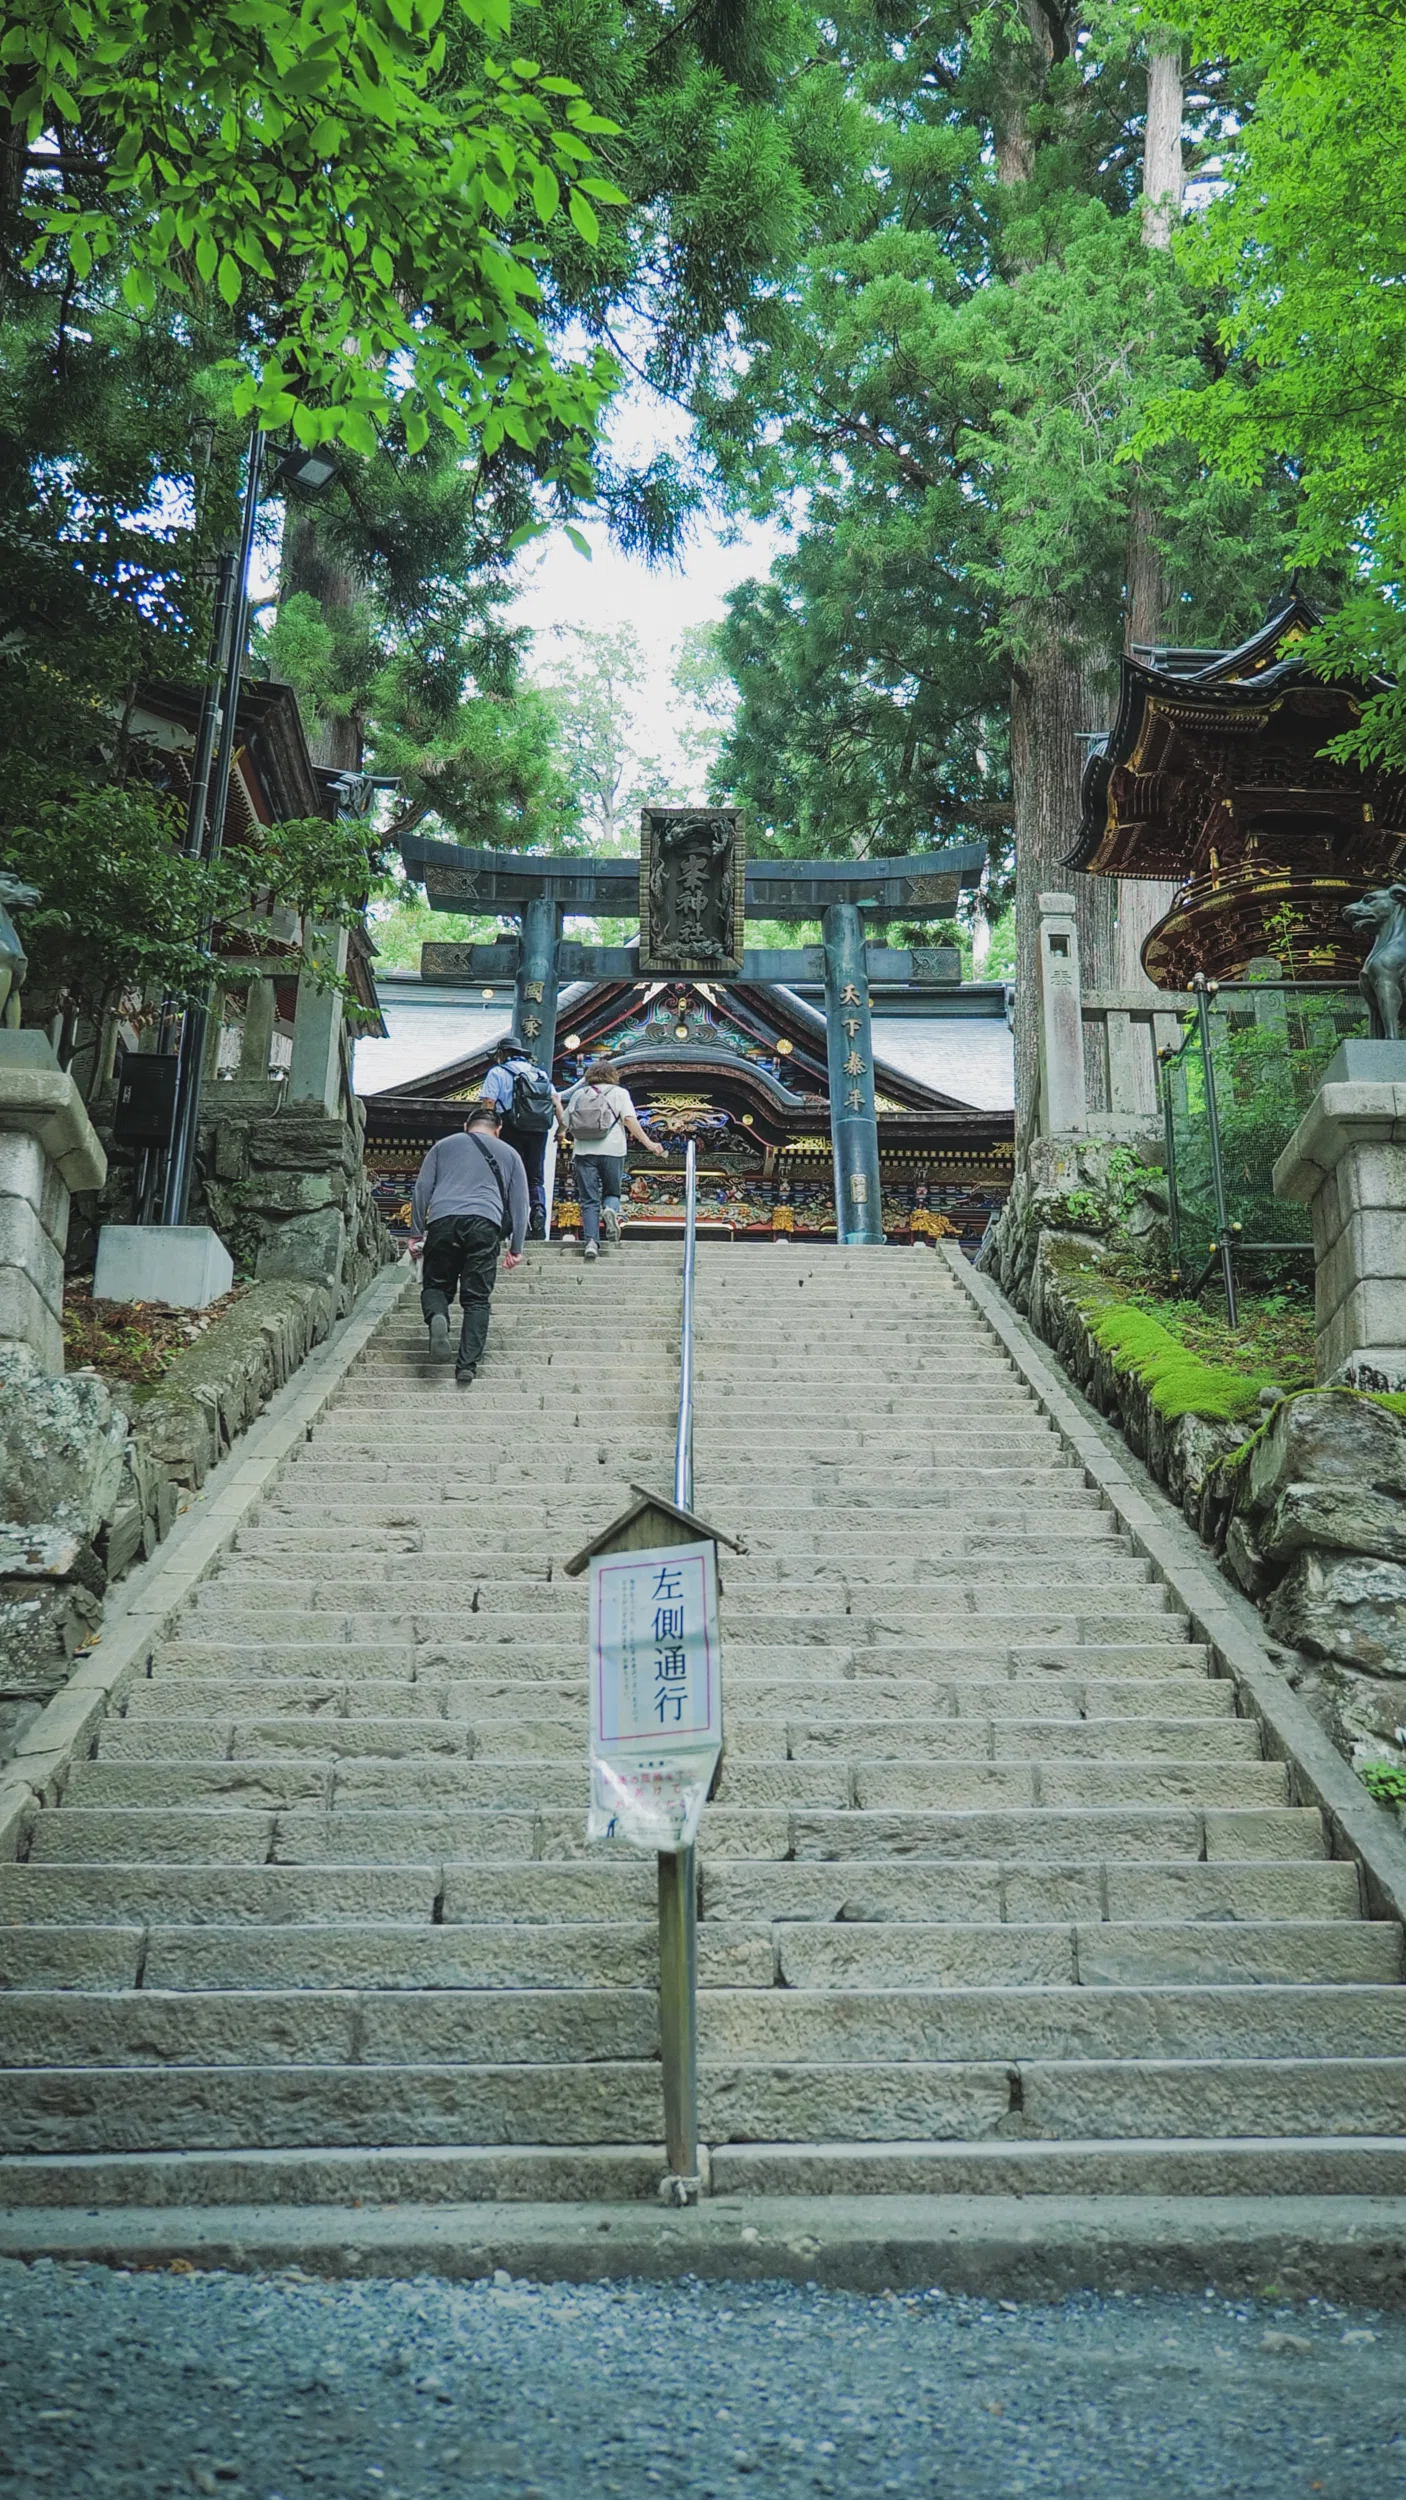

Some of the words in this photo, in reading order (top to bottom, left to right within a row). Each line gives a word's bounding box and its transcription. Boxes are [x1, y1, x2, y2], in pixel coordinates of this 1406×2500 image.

[521, 981, 545, 1064] 國家
[839, 984, 868, 1113] 天下泰平
[651, 1567, 688, 1723] 左側通行
